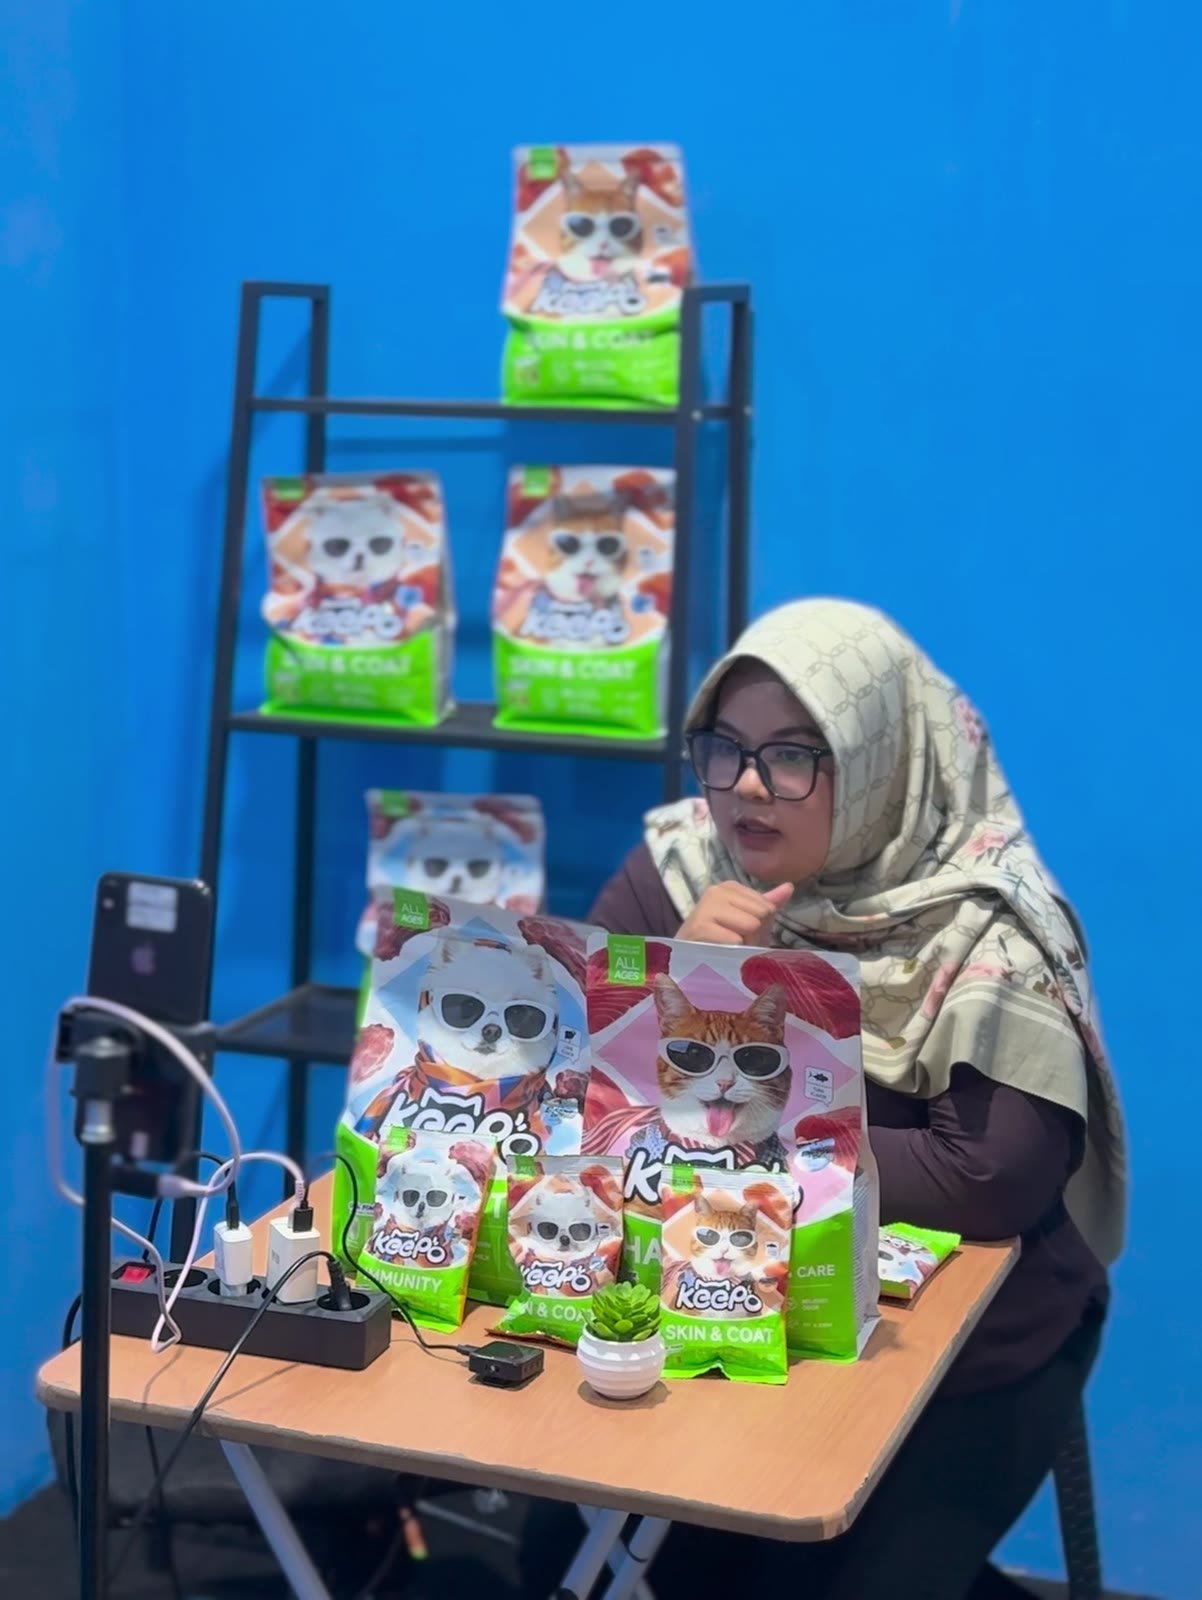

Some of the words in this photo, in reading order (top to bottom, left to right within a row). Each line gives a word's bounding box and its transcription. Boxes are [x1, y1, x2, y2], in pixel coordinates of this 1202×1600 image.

[401, 903, 424, 916] ALL
[400, 913, 424, 925] AGES
[615, 956, 640, 971] ALL
[614, 970, 640, 981] AGES
[796, 1264, 836, 1278] CARE
[552, 1305, 597, 1323] COA
[665, 1324, 707, 1341] SKIN
[710, 1325, 723, 1343] &
[726, 1326, 775, 1345] COAT
